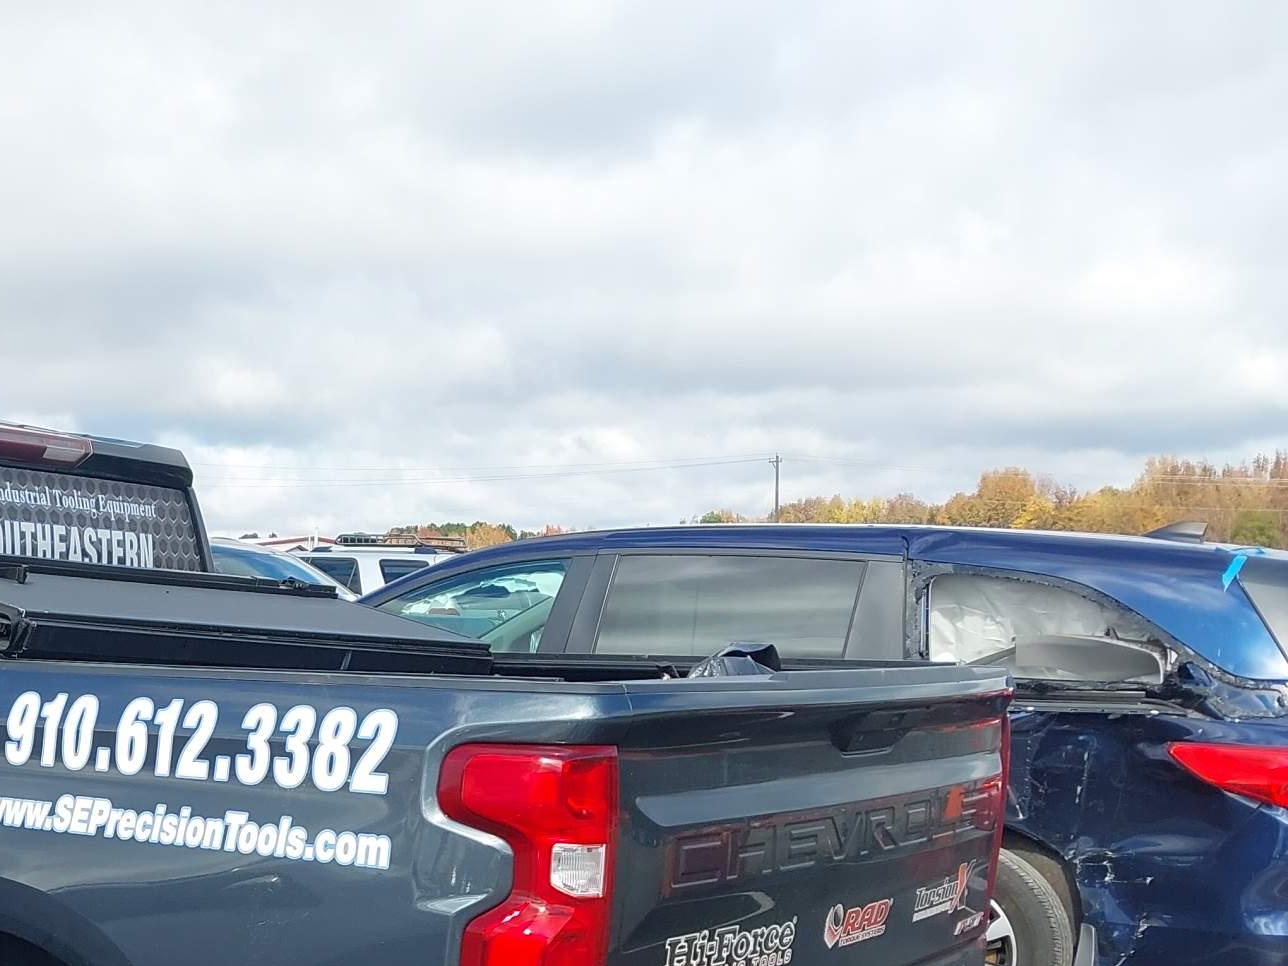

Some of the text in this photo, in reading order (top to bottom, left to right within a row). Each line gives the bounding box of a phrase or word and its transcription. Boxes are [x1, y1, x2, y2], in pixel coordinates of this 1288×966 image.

[52, 488, 98, 518] Tooling
[98, 494, 156, 522] Equipment
[4, 690, 399, 796] 910.612.3382
[841, 899, 892, 937] RAD
